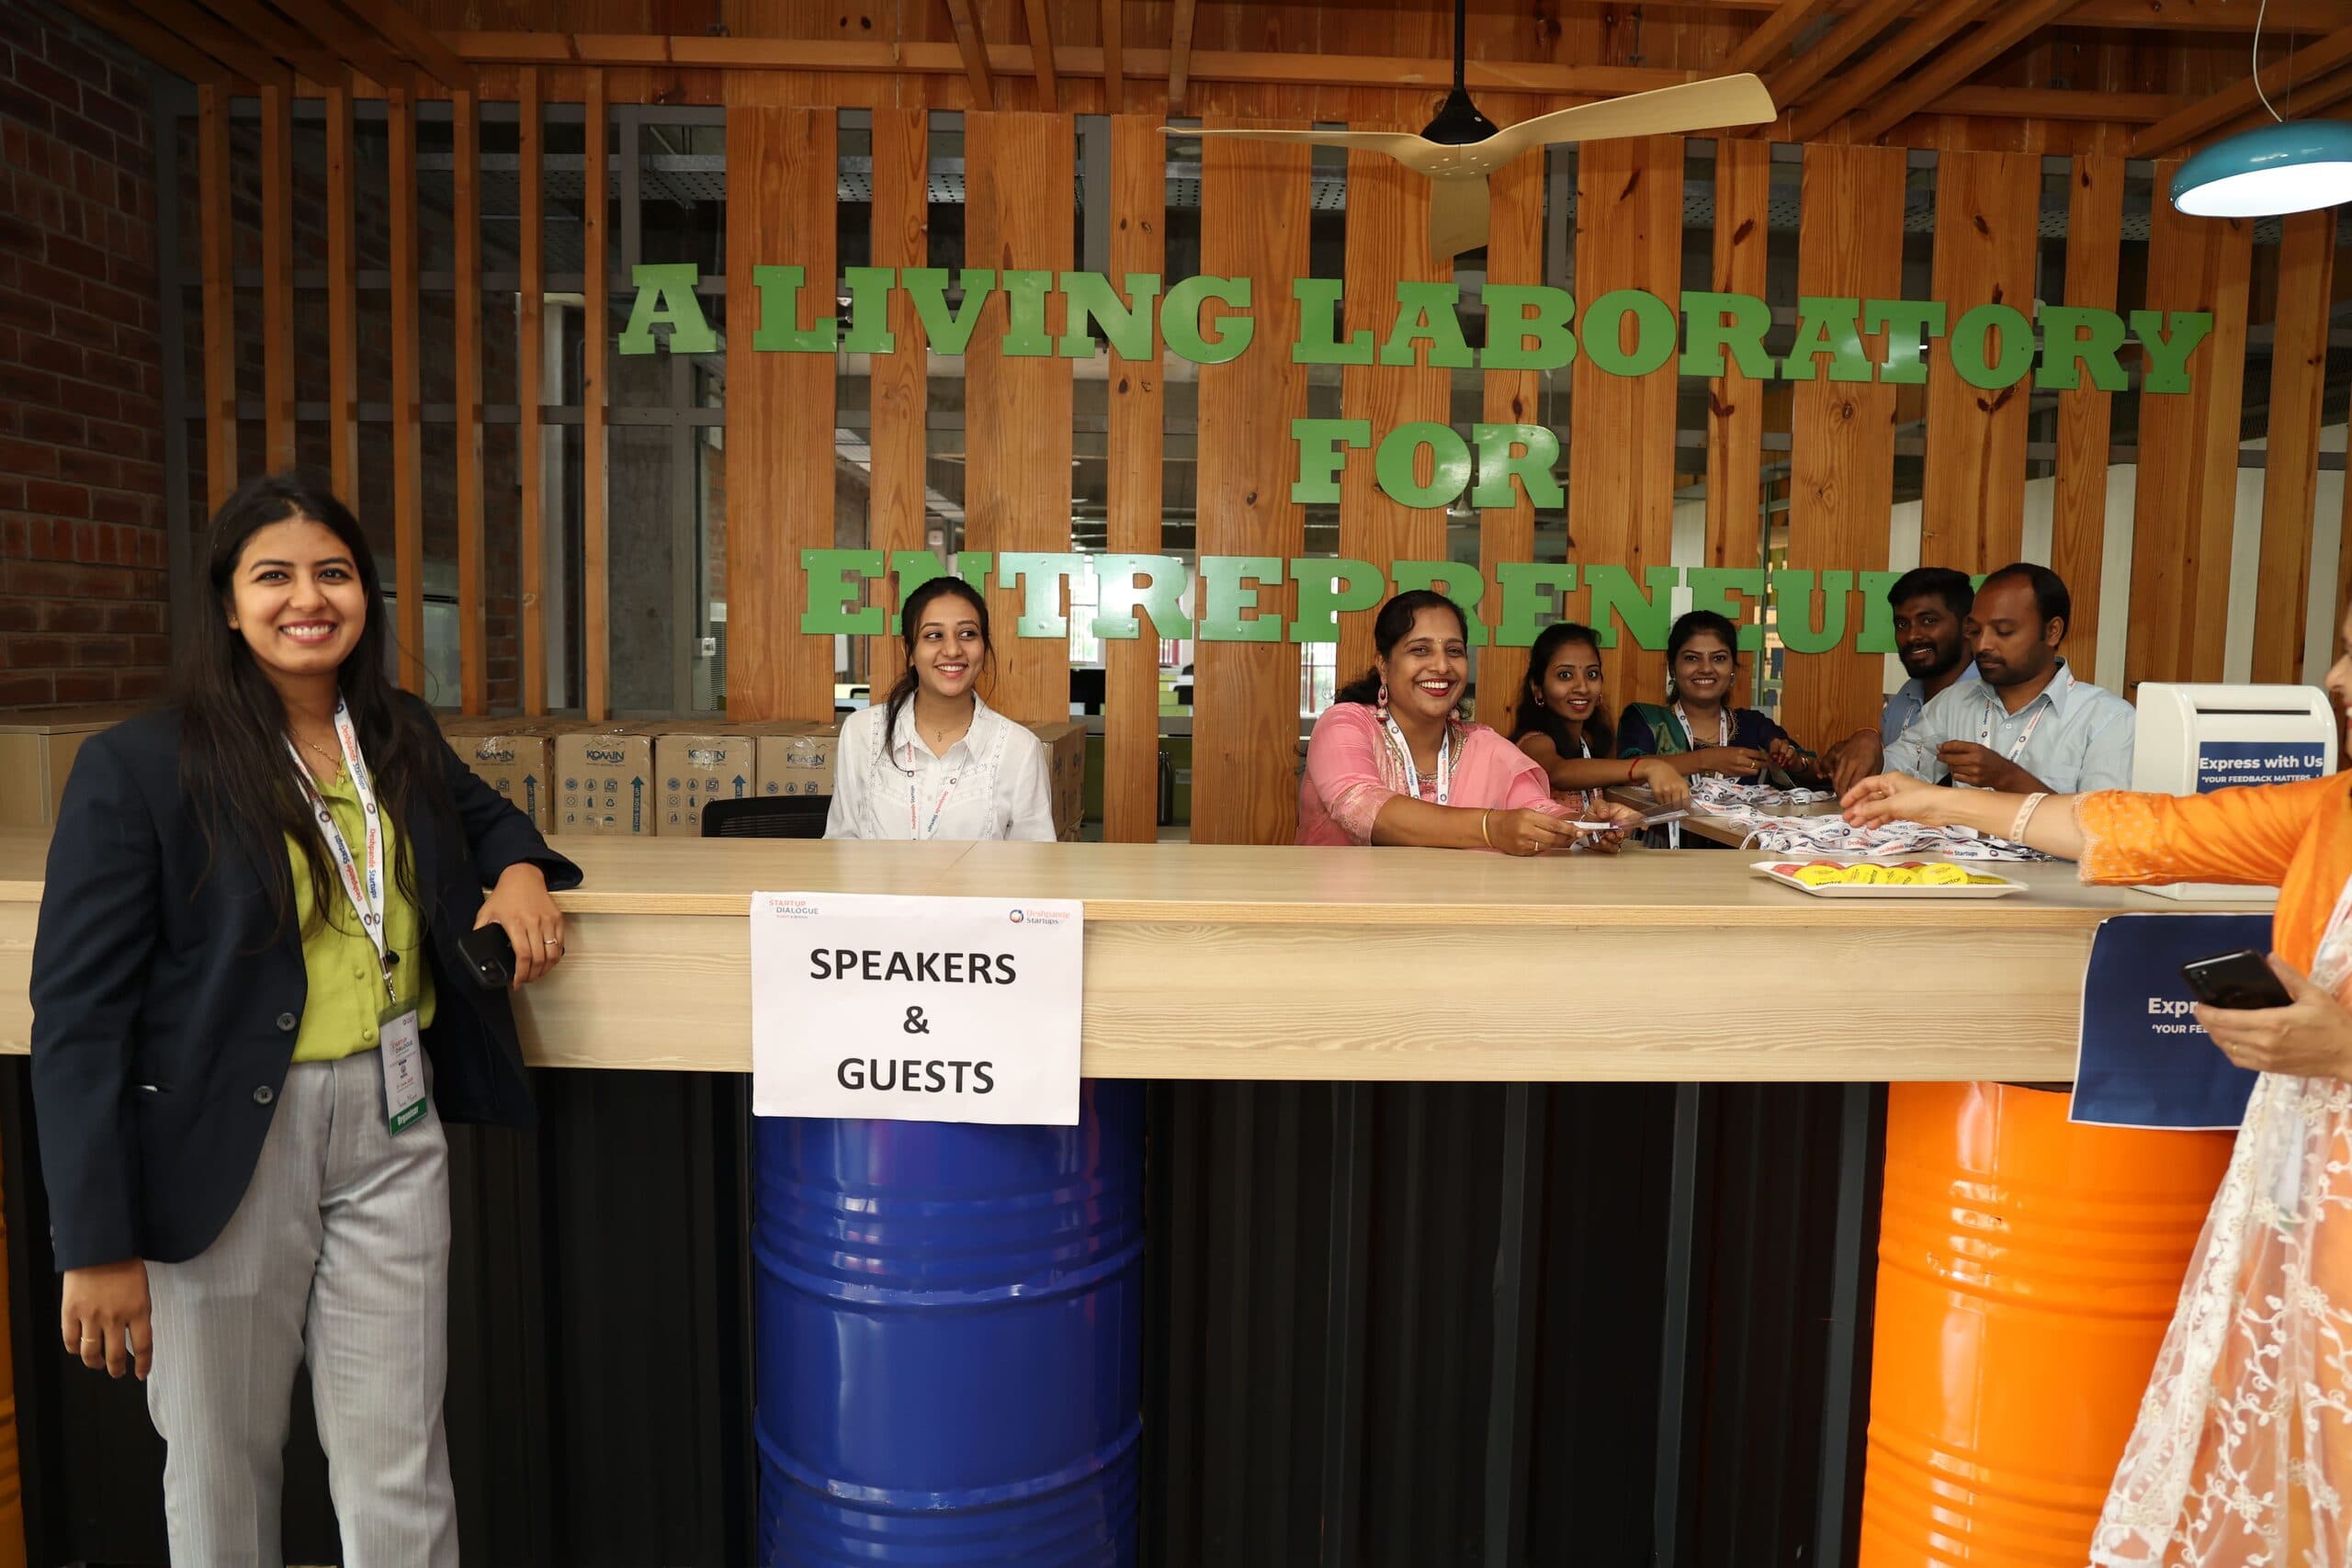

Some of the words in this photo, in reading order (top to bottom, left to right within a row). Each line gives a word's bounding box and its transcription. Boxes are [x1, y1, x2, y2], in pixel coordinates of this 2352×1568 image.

[618, 263, 718, 355] A
[752, 265, 1254, 365] LIVING
[1292, 277, 2213, 395] LABORATORY
[1291, 418, 1565, 509] FOR
[2199, 758, 2261, 773] Express
[2264, 755, 2300, 768] with
[2303, 755, 2324, 768] Us
[369, 869, 378, 899] Startups
[776, 907, 820, 915] DIALOGUE
[810, 948, 1016, 985] SPEAKERS
[903, 1006, 930, 1034] &
[837, 1057, 994, 1094] GUESTS
